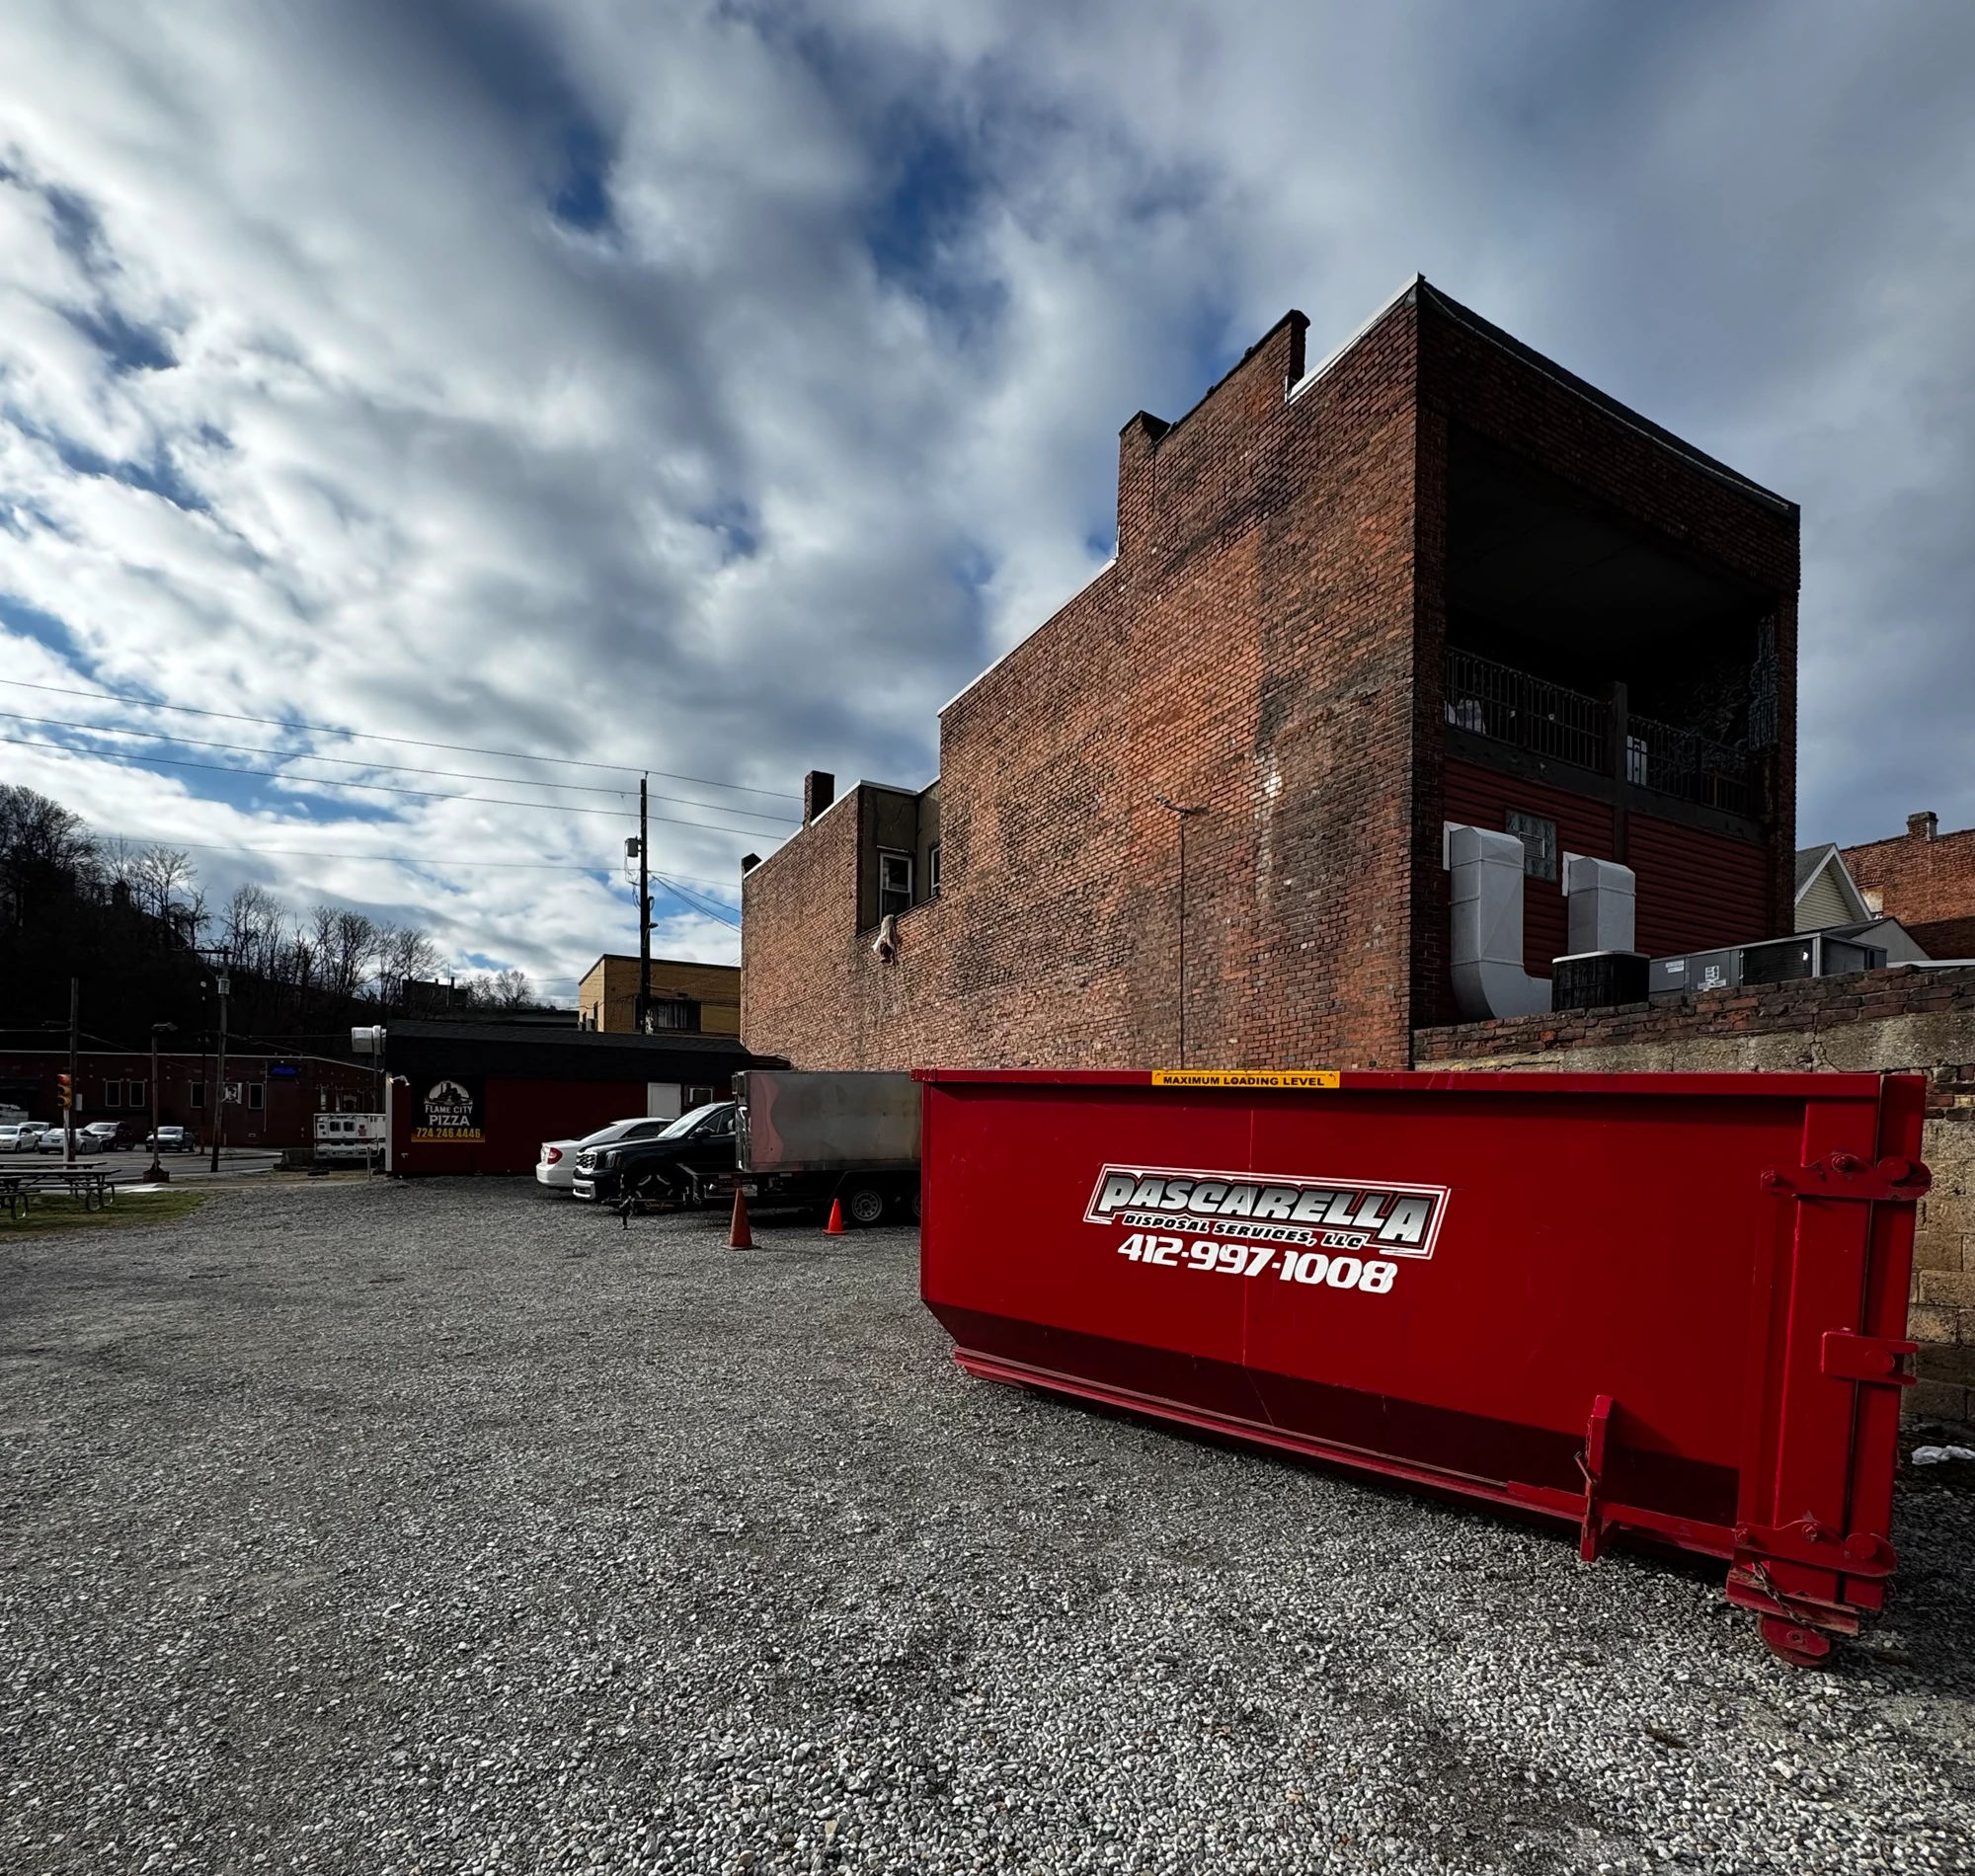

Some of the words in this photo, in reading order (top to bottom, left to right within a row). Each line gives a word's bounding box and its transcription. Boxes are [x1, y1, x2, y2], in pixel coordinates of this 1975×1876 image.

[1163, 1076, 1220, 1085] MAXIMUM
[1224, 1076, 1279, 1086] LOADING
[1283, 1077, 1325, 1086] LEVEL
[425, 1104, 451, 1114] FLAME
[453, 1105, 473, 1114] CITY
[429, 1115, 470, 1126] PIZZA
[416, 1128, 481, 1138] 724.246.4446
[1098, 1176, 1431, 1243] PASCARELLA
[1125, 1214, 1208, 1232] DISPOSAL
[1215, 1223, 1315, 1245] SERVICES,
[1322, 1234, 1364, 1248] LLC
[1117, 1233, 1398, 1294] 412-997-1008
